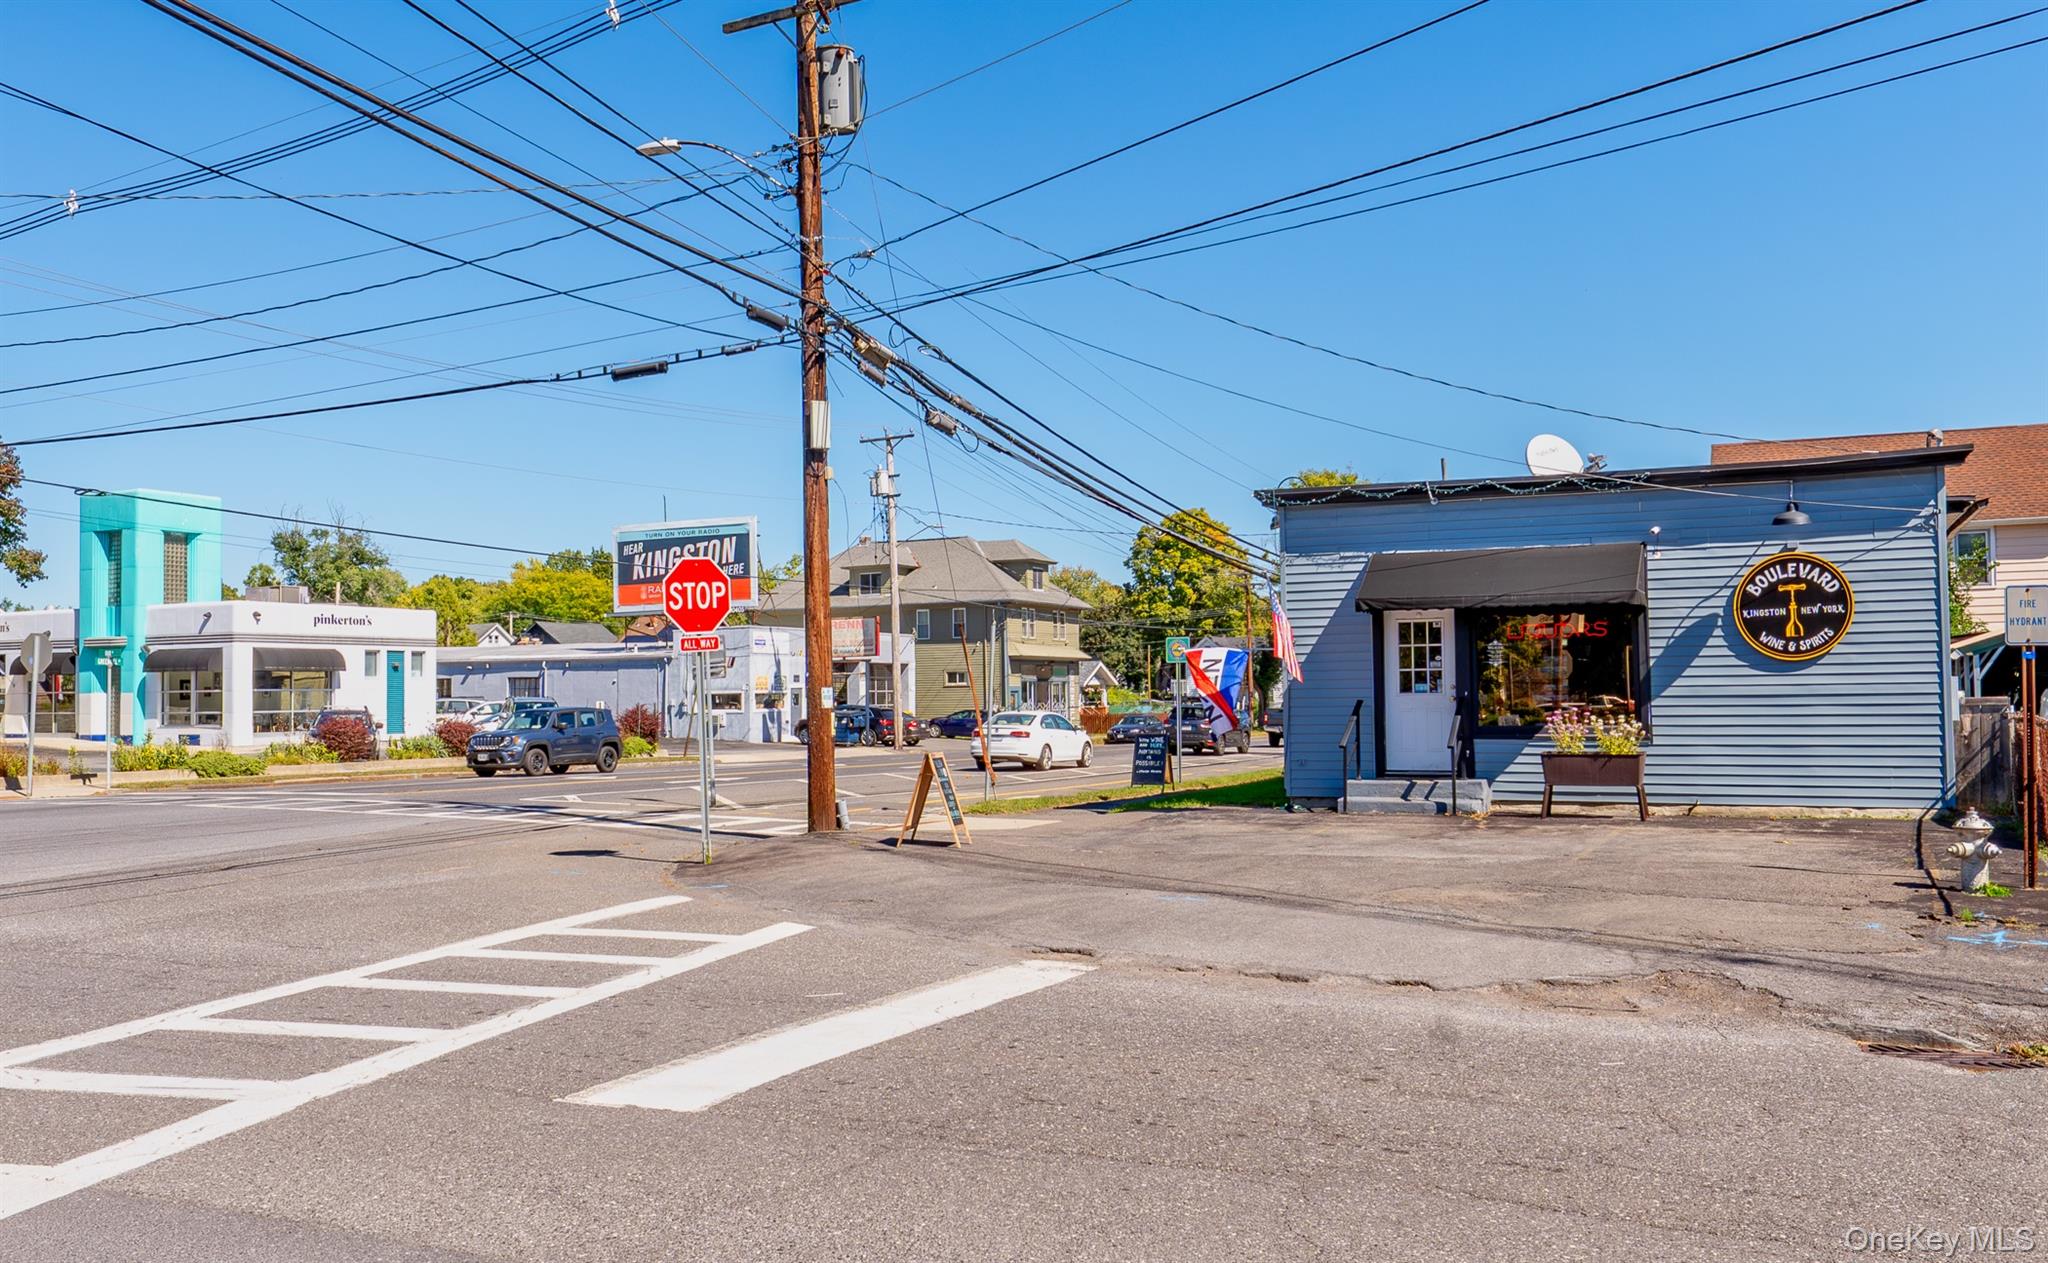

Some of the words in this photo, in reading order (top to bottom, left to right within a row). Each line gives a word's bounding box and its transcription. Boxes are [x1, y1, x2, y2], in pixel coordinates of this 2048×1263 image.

[623, 542, 644, 556] HEAR
[1746, 563, 1840, 597] BOULEVARD
[669, 581, 726, 611] STOP
[1742, 607, 1787, 618] KINGSTON
[1801, 603, 1821, 614] NEW
[1822, 605, 1845, 614] YORK
[2019, 599, 2037, 608] FIRE
[313, 613, 373, 627] pinkerton's
[2009, 616, 2047, 626] HYDRANT
[683, 640, 698, 650] ALL
[700, 638, 716, 649] WAY
[1760, 631, 1786, 650] WINE
[1788, 641, 1797, 652] &
[1800, 627, 1834, 650] SPIRITS
